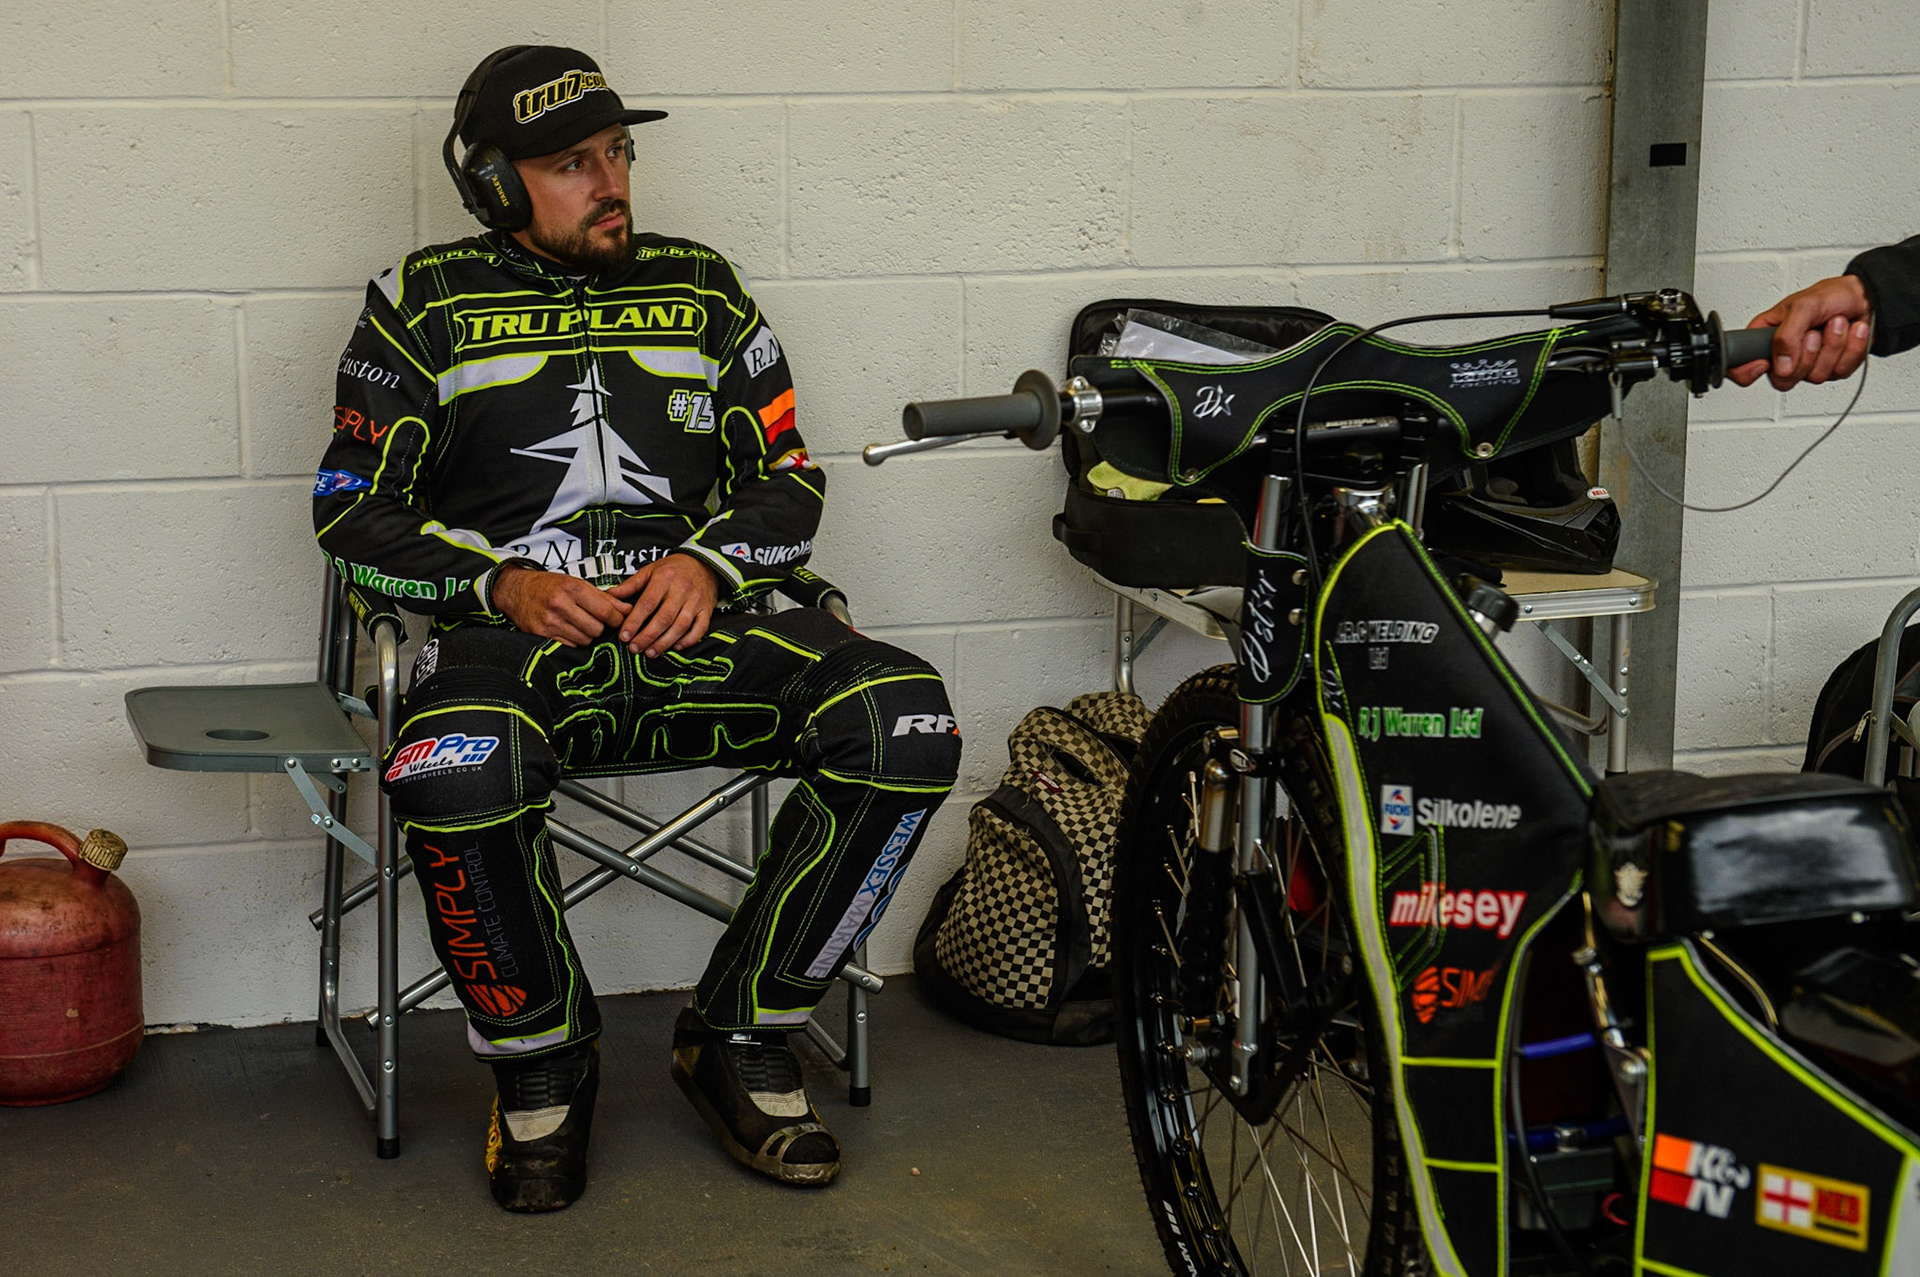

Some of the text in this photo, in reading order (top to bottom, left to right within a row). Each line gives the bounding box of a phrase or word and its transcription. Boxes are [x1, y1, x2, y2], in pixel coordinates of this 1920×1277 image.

[447, 249, 497, 264] PLAT
[669, 248, 718, 260] PLANT
[468, 304, 697, 341] TRU PLANT
[668, 389, 716, 433] #15
[350, 563, 437, 600] Warren
[1367, 620, 1440, 644] WELDING
[1382, 706, 1446, 738] Warren
[1447, 706, 1485, 739] Ltd
[409, 756, 454, 774] Wheels
[1384, 797, 1522, 830] FUCHS Silkolene
[424, 841, 498, 980] SIMPLY
[464, 841, 519, 978] CLIMATE CONTROL
[812, 809, 924, 977] WESSEX MARINE
